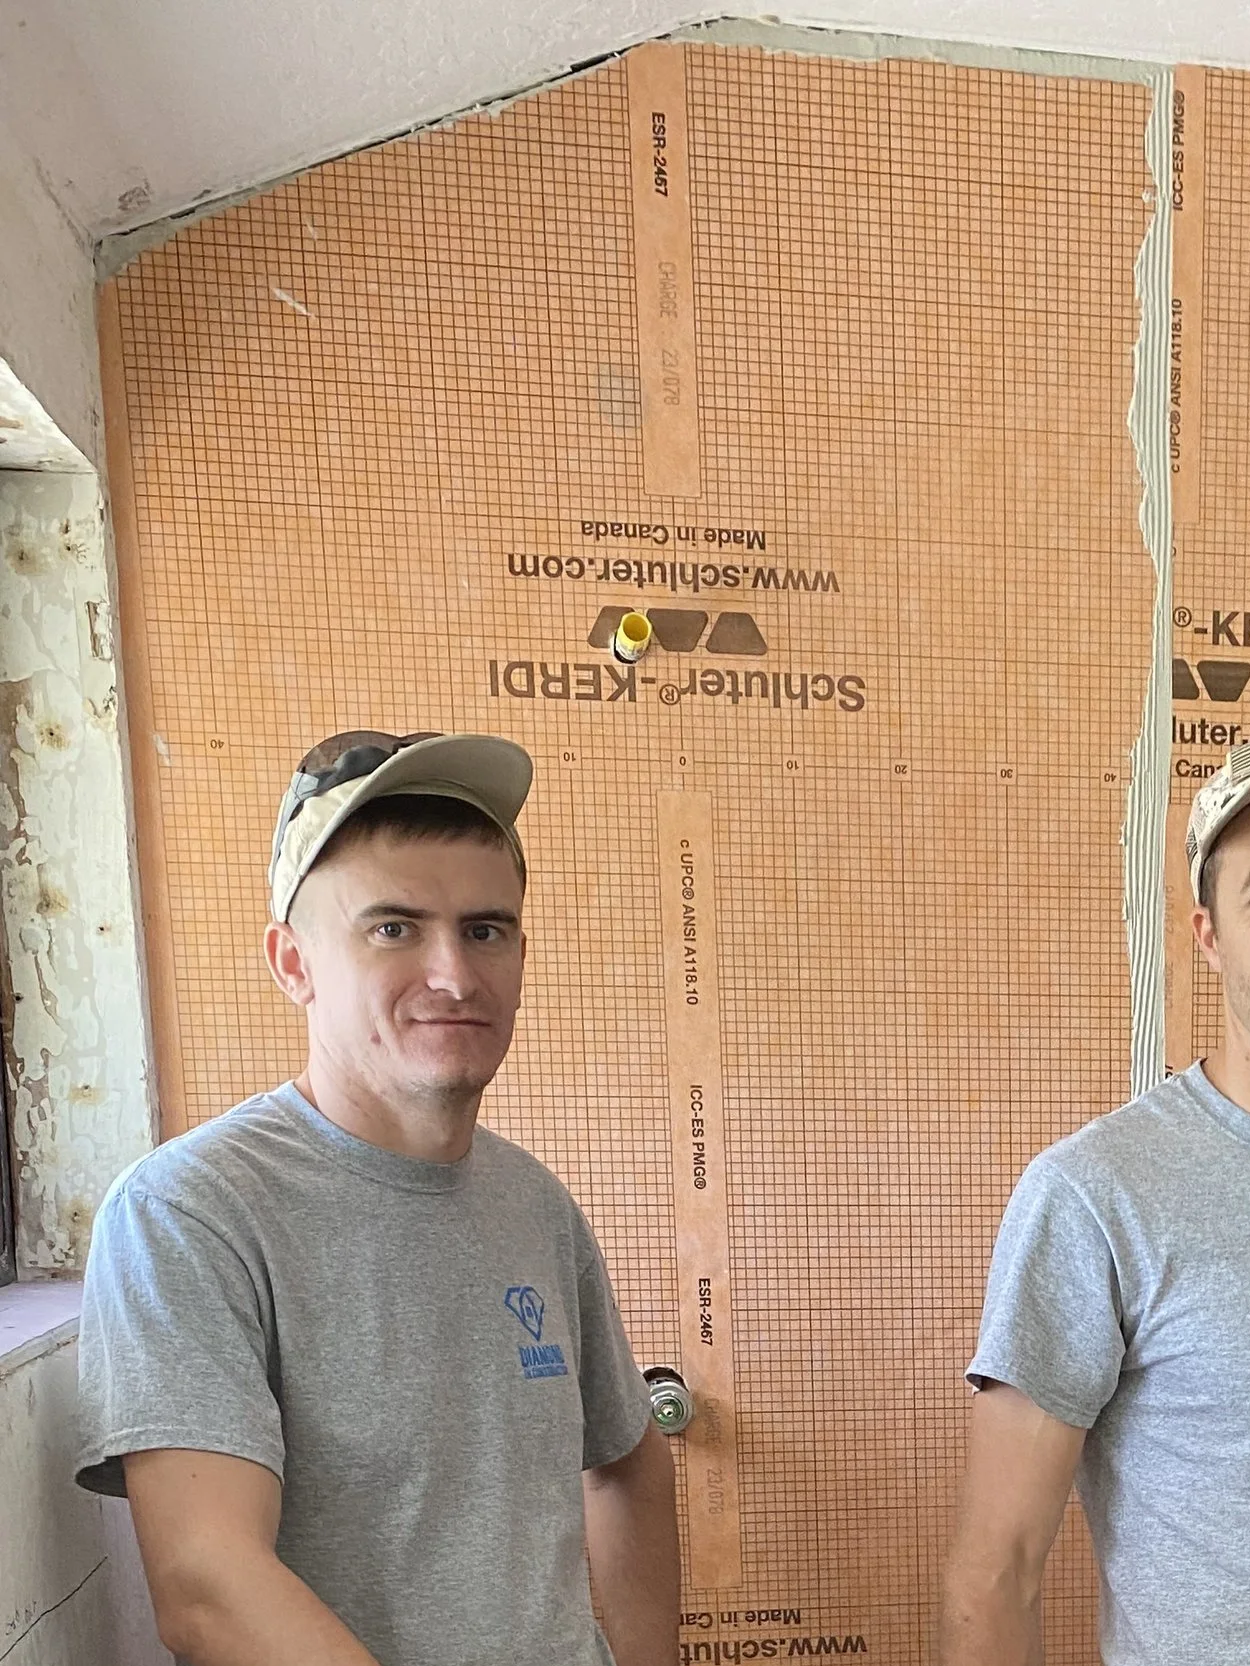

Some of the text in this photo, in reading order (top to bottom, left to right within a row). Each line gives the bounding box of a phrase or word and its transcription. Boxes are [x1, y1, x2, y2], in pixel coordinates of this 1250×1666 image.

[651, 111, 669, 197] ESR-2467
[1173, 148, 1184, 211] ICC-ES
[658, 261, 680, 406] CHARGE 23/078
[1171, 299, 1182, 363] A118.10
[1171, 367, 1182, 407] ANSI
[1170, 410, 1181, 460] UPC®
[581, 520, 766, 549] Made in Canada
[507, 553, 841, 594] www.schluter.com
[489, 660, 866, 712] Schluter®-KERDI
[210, 739, 224, 749] 40
[563, 752, 576, 762] 10
[786, 760, 799, 770] 10
[895, 765, 907, 774] 20
[1000, 769, 1013, 779] 30
[1103, 773, 1116, 782] 40
[680, 839, 699, 1005] c UPC® ANSI A118.10
[691, 1084, 707, 1189] ICC-ES PMG®
[698, 1277, 713, 1347] ESR-2467
[721, 1609, 738, 1627] in
[745, 1608, 801, 1627] Made
